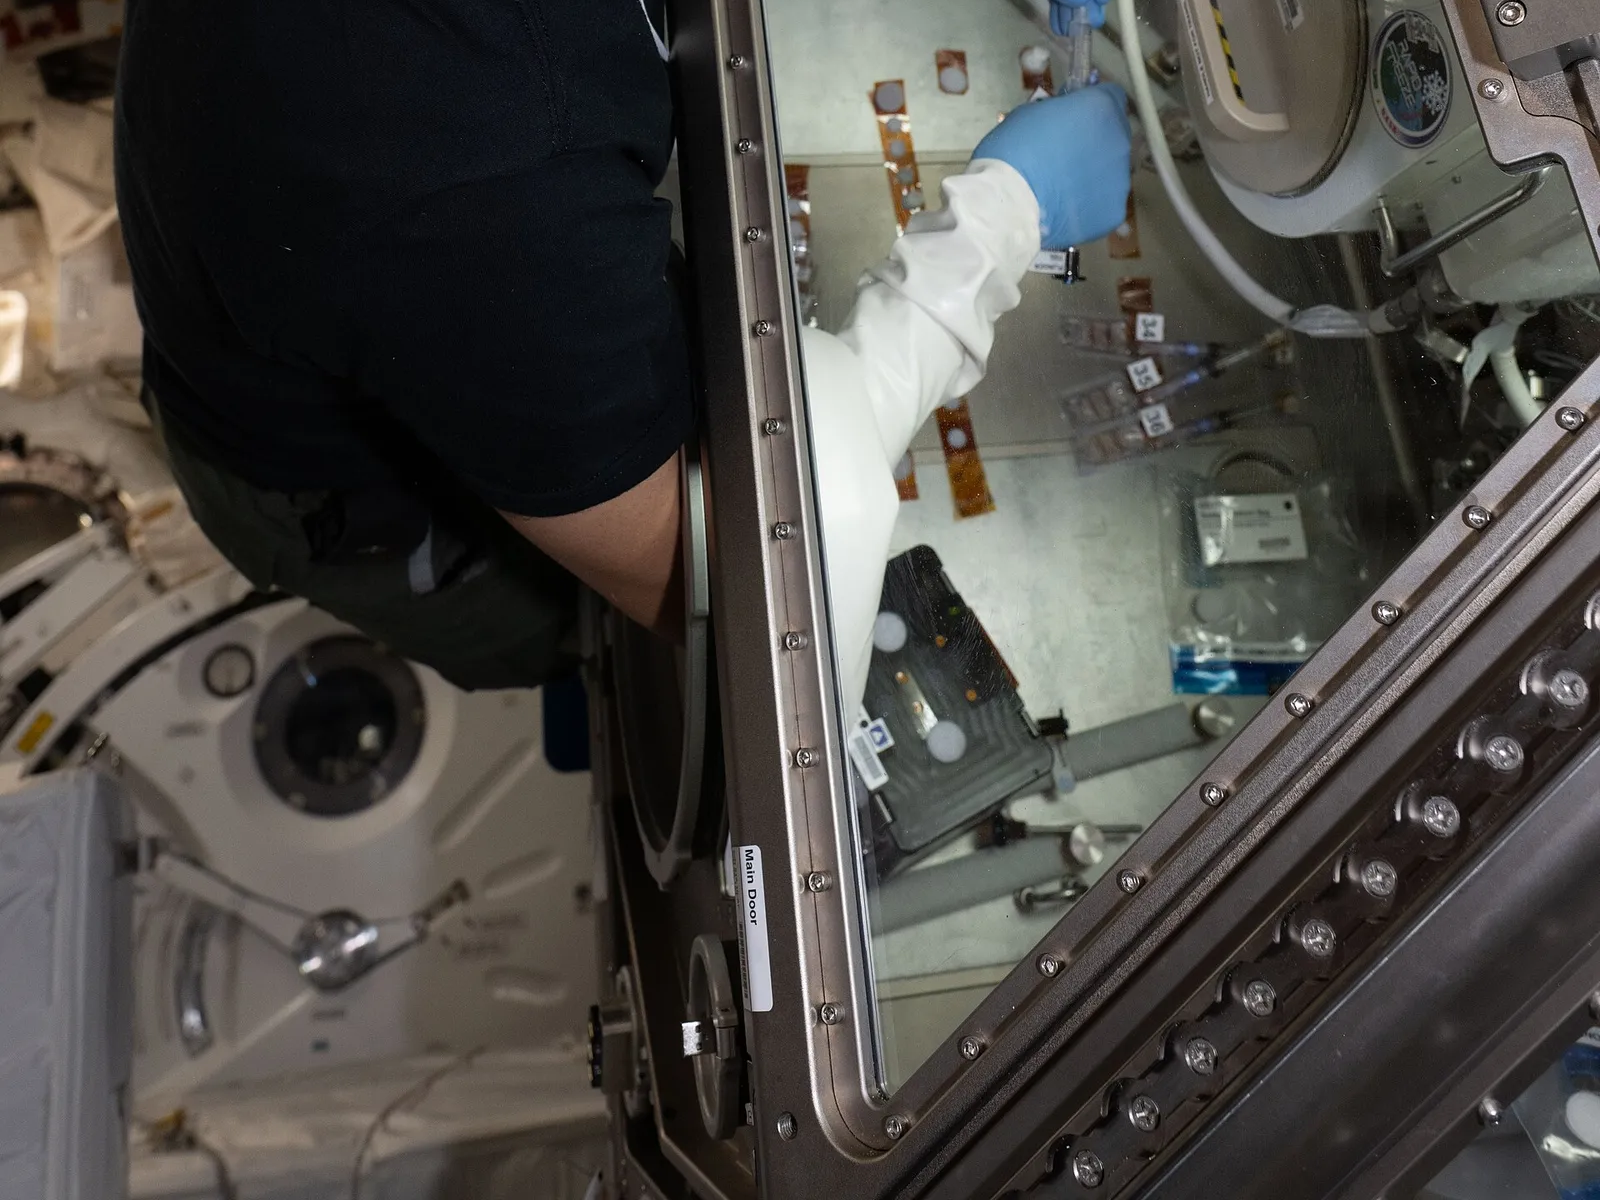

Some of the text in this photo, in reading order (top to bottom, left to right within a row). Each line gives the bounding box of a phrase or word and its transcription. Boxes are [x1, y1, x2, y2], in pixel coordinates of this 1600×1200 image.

[1386, 40, 1416, 109] FREEZE
[1399, 38, 1422, 91] RAPID
[1142, 318, 1157, 337] 34
[1133, 364, 1153, 386] 35
[745, 849, 757, 925] Main Door
